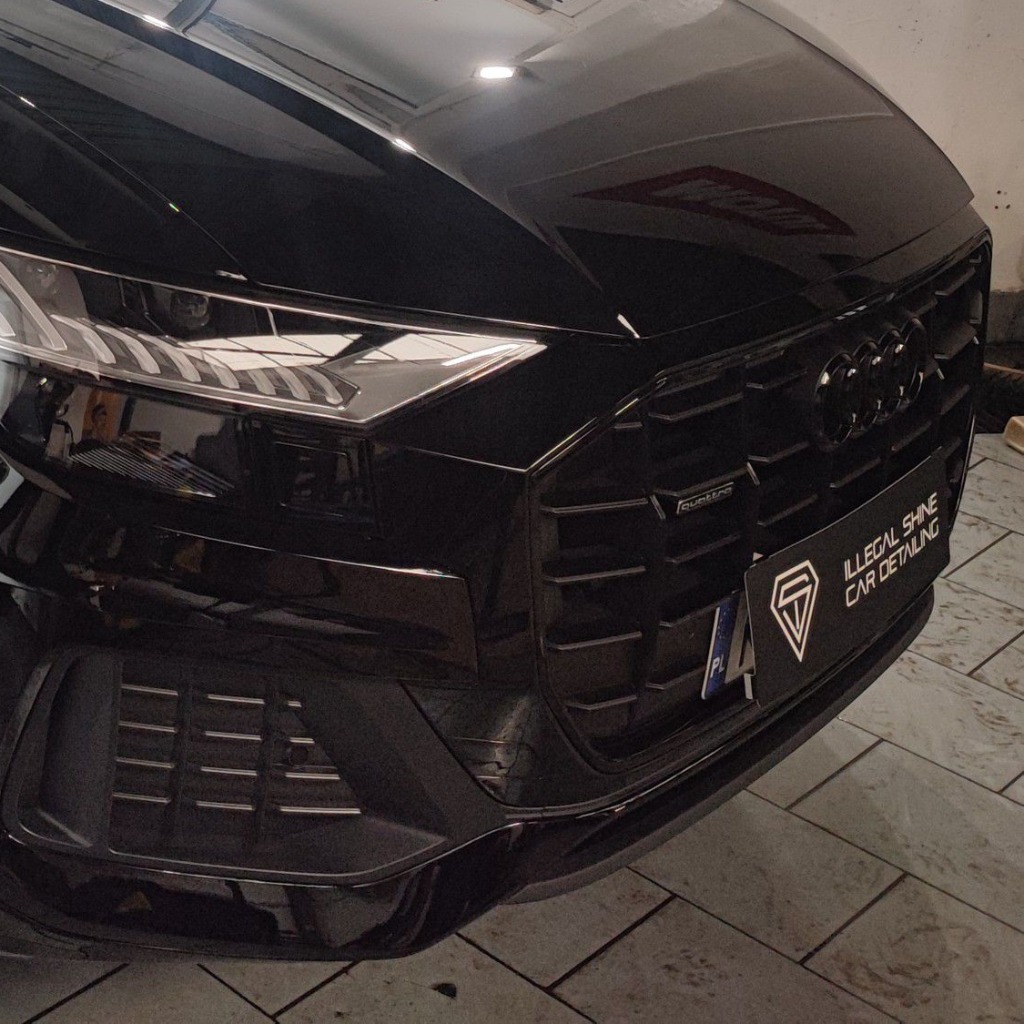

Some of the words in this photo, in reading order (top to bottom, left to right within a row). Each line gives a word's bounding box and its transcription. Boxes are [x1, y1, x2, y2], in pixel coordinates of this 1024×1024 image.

[681, 487, 733, 512] quattro
[843, 527, 899, 582] ILLEGAL
[902, 492, 938, 537] SHINE
[845, 575, 876, 608] CAR
[879, 516, 940, 583] DETAILING
[710, 654, 725, 679] PL
